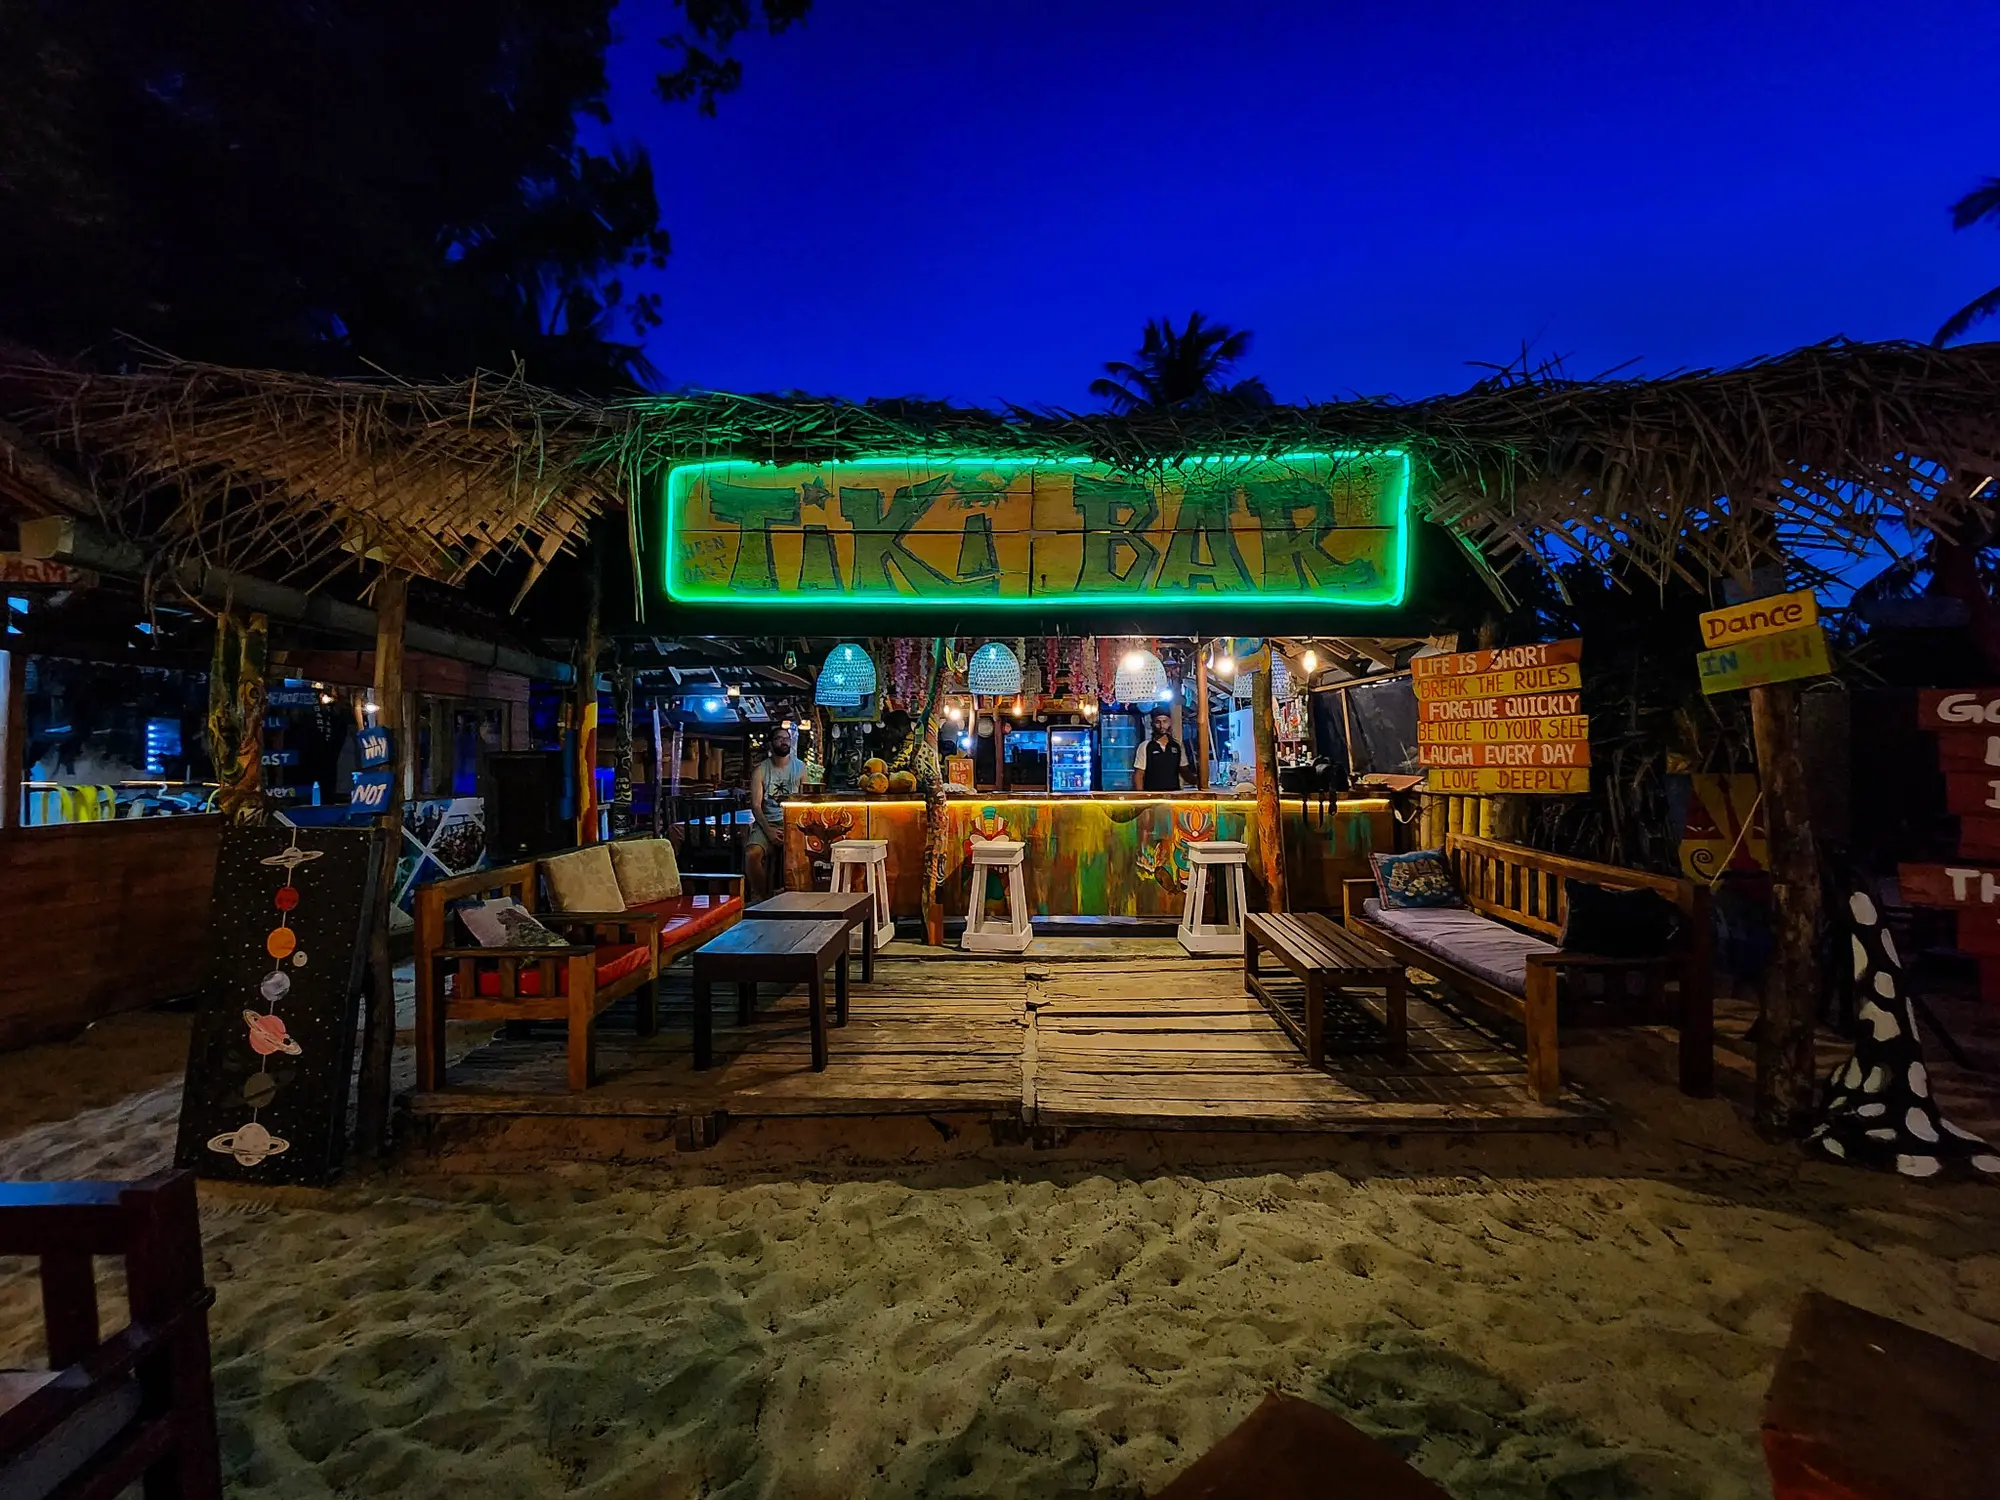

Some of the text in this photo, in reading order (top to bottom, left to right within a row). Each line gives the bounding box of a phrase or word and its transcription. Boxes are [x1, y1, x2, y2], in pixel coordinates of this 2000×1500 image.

[1073, 474, 1383, 592] BAR
[1707, 603, 1802, 640] Dance
[1418, 645, 1549, 677] LIFE IS SHORT
[1702, 635, 1812, 676] IN TIKI
[1418, 667, 1570, 699] BREAK THE RULES
[1429, 695, 1579, 721] FORGIVE QUICKLY
[1419, 718, 1588, 741] BE NICE TO YOUR SELF
[1420, 743, 1576, 765] LAUGH EVERY DAY
[351, 783, 387, 805] NOT
[1442, 770, 1572, 790] LOVE DEEPLY
